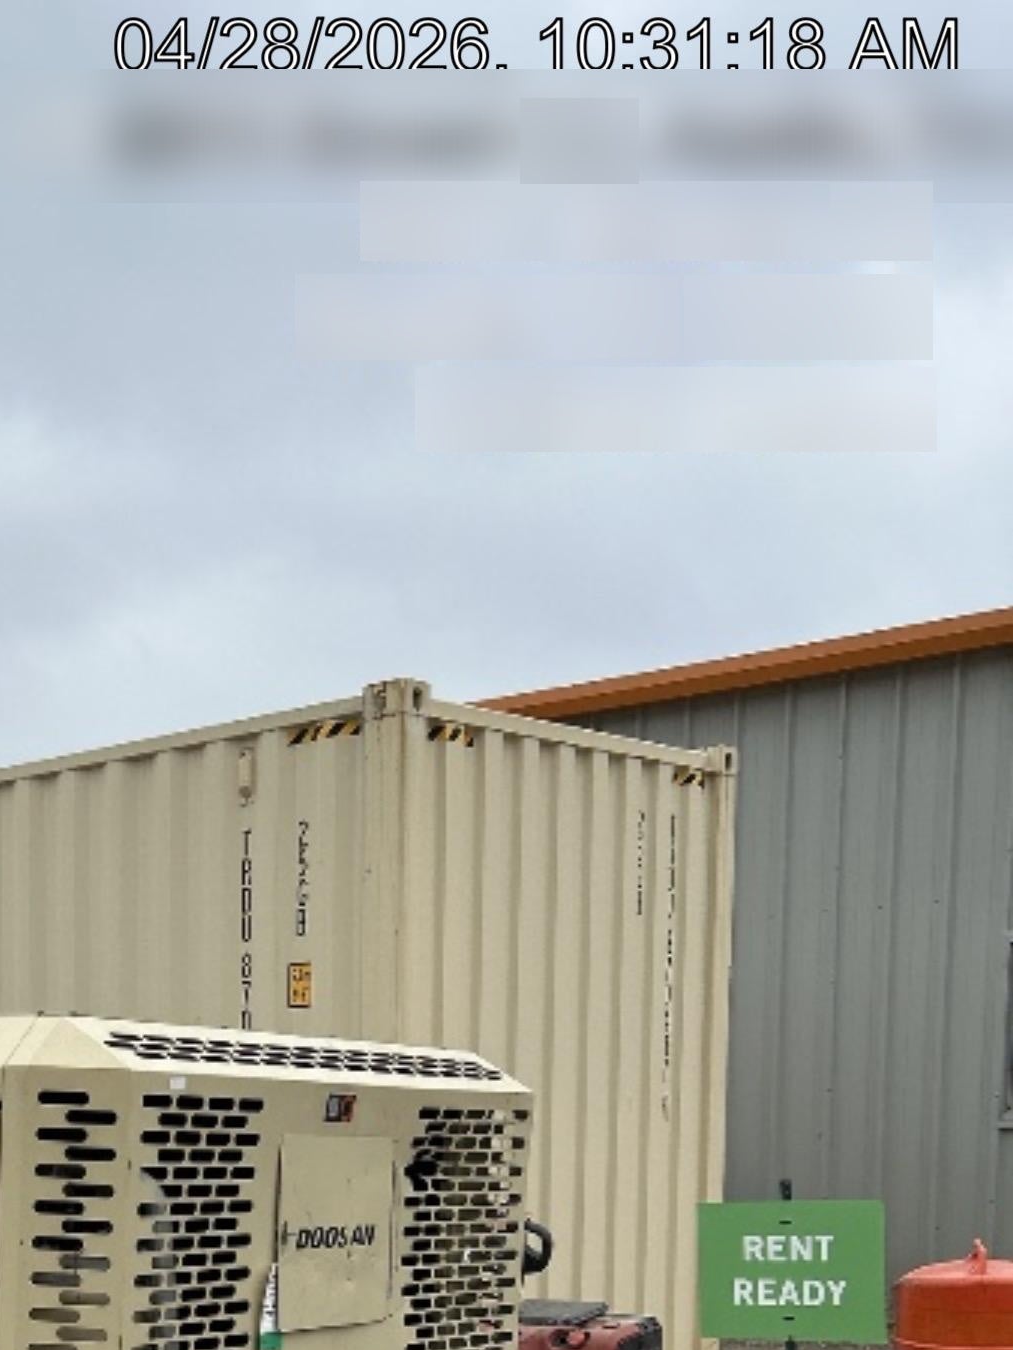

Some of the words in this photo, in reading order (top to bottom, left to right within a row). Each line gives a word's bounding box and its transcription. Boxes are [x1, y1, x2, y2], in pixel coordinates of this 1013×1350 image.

[295, 1224, 376, 1250] DOOSAN
[742, 1235, 835, 1262] RENT
[732, 1278, 847, 1307] READY
